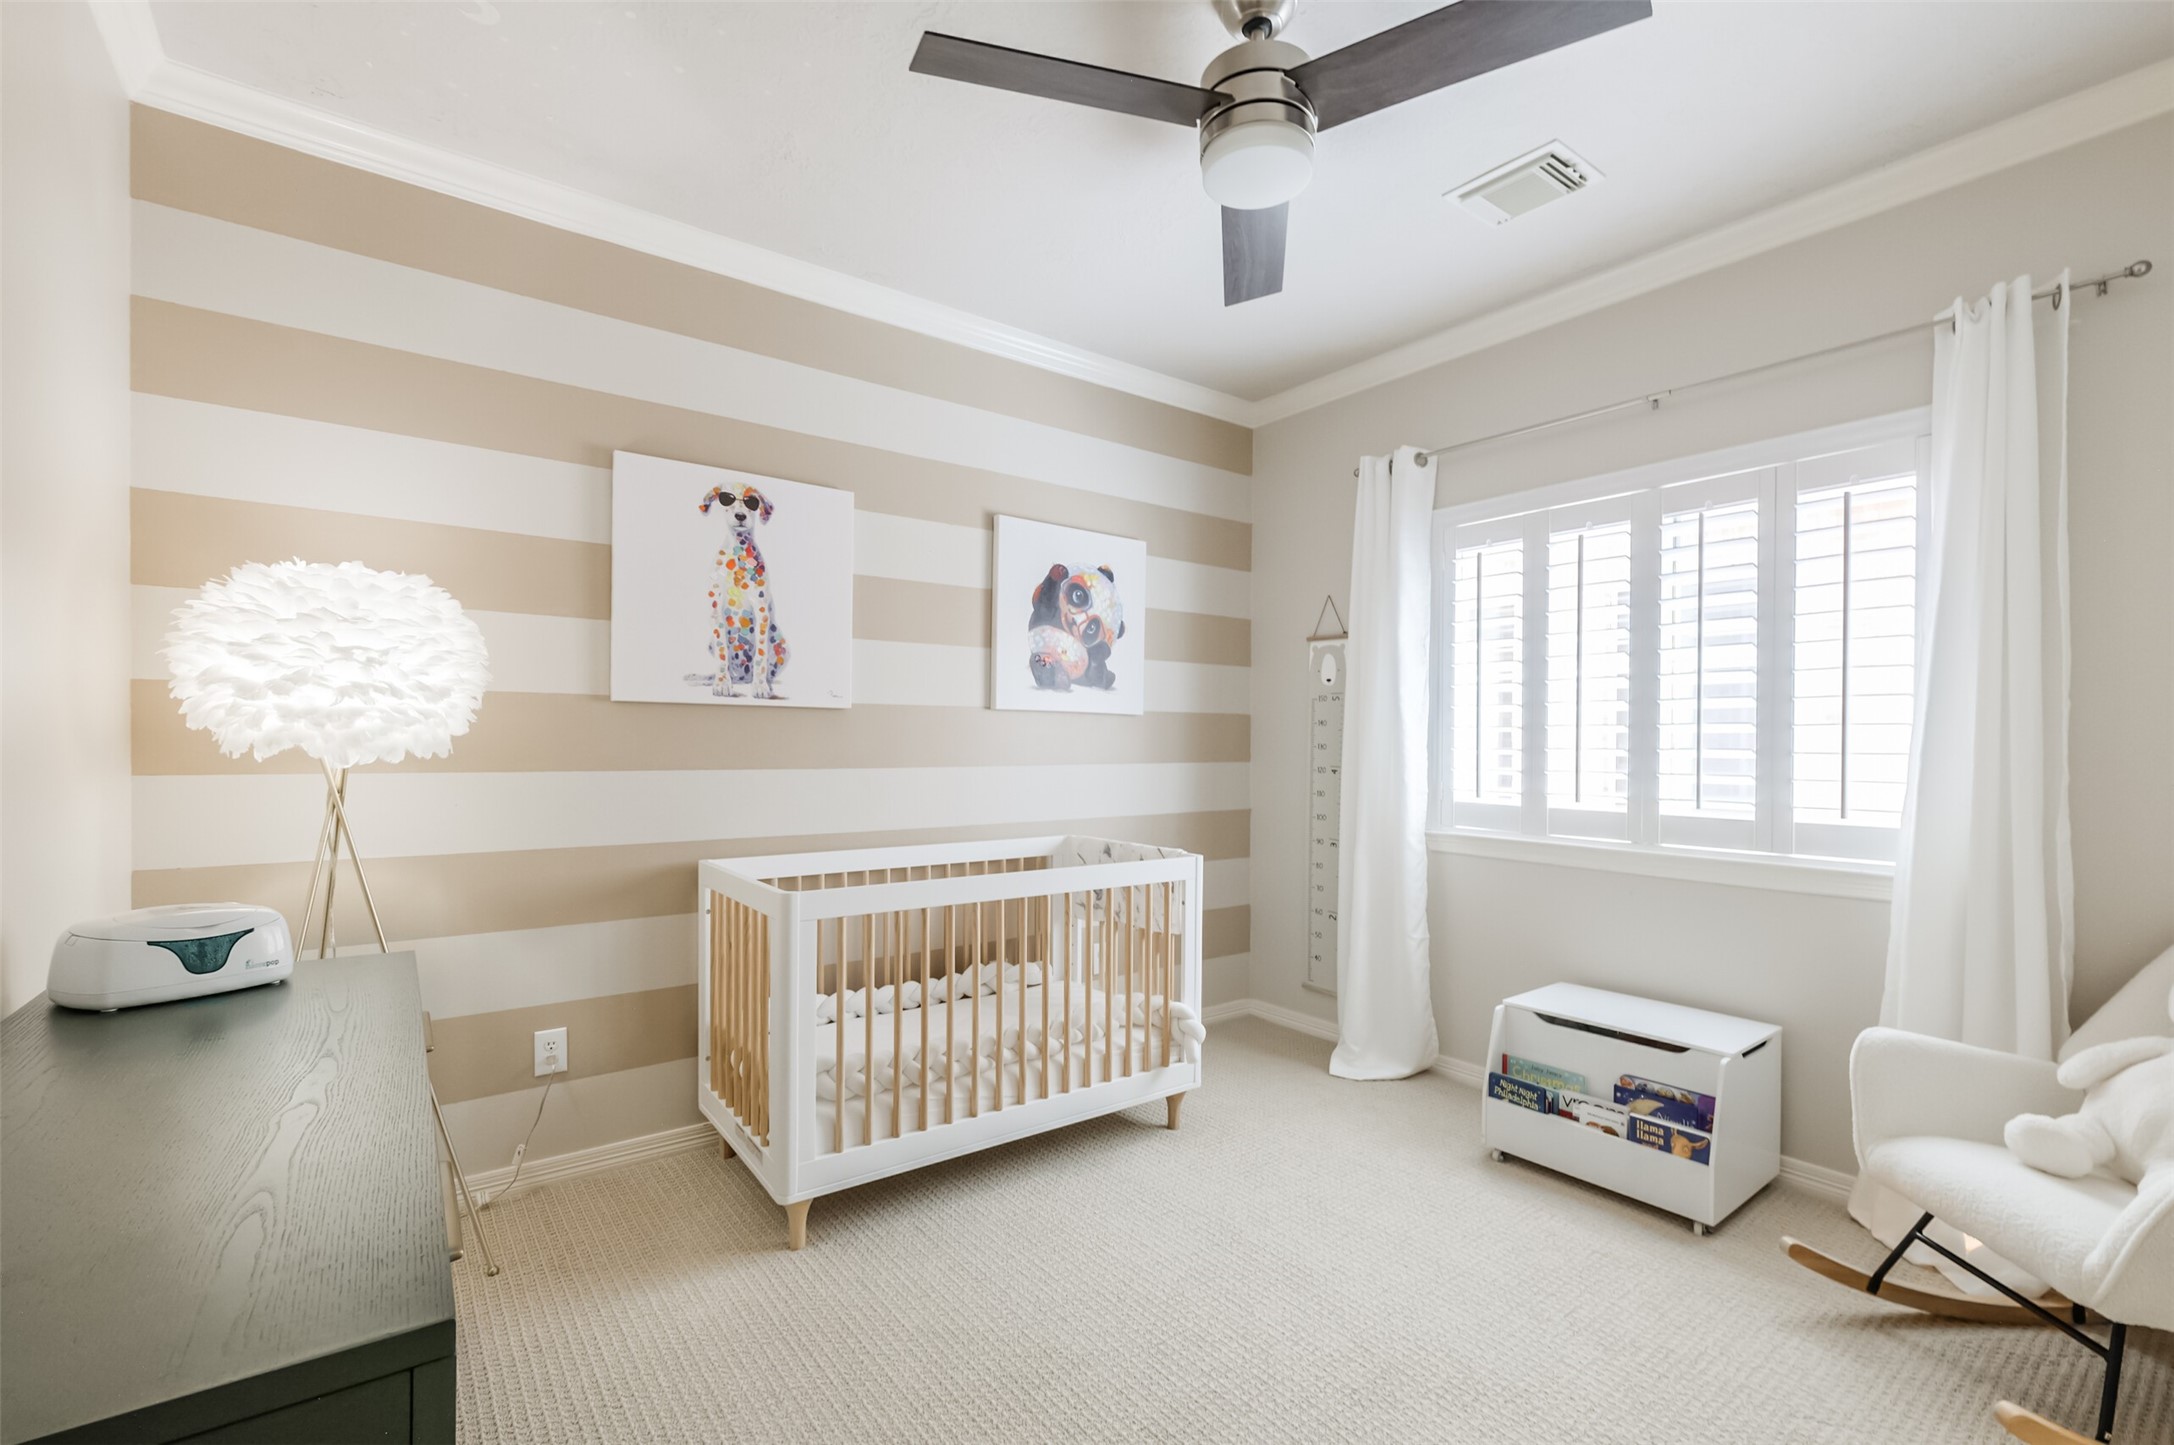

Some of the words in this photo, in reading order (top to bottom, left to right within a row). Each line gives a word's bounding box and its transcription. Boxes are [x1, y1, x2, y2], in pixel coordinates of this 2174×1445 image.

[1494, 1086, 1539, 1111] Philadelphia
[1500, 1079, 1518, 1092] Night
[1518, 1088, 1538, 1101] Night
[1636, 1119, 1664, 1136] llama
[1636, 1128, 1664, 1146] llama
